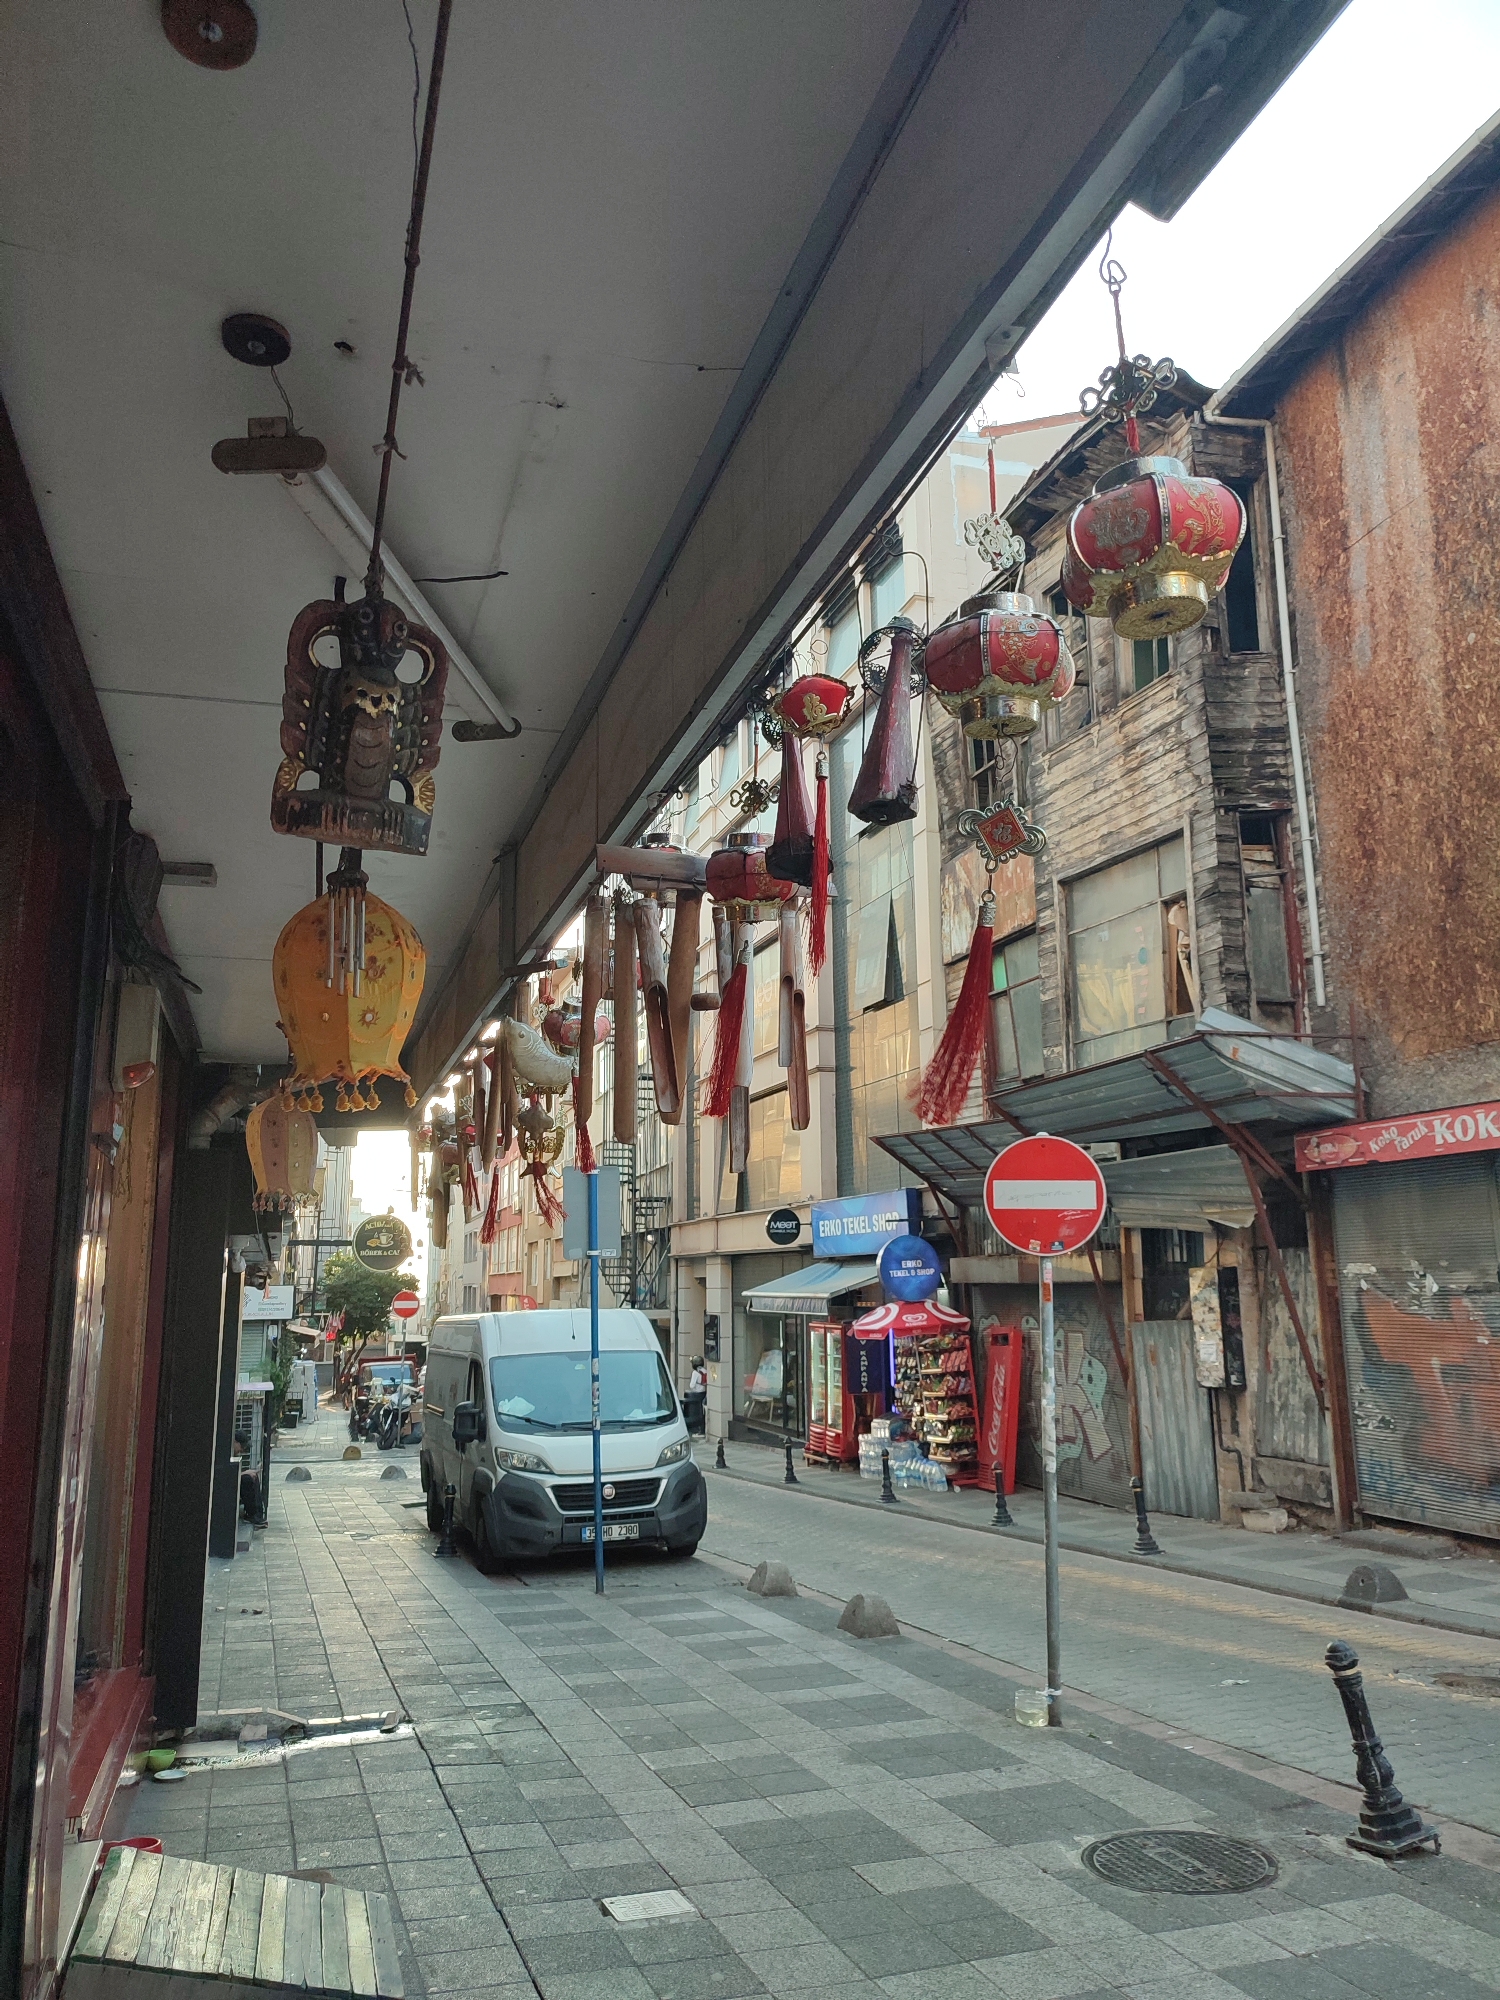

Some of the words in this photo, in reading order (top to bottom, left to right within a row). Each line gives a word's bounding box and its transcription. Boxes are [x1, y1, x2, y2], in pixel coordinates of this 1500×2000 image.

[1368, 1125, 1399, 1154] Koko
[819, 1218, 842, 1238] ERKO
[842, 1215, 872, 1235] TEKEL
[873, 1212, 899, 1232] SHOP
[889, 1269, 911, 1278] TEKEL
[916, 1267, 936, 1276] SHOP
[901, 1259, 923, 1269] ERKO
[859, 1350, 869, 1393] KAMPANYA
[988, 1359, 1006, 1456] Coca-Cola
